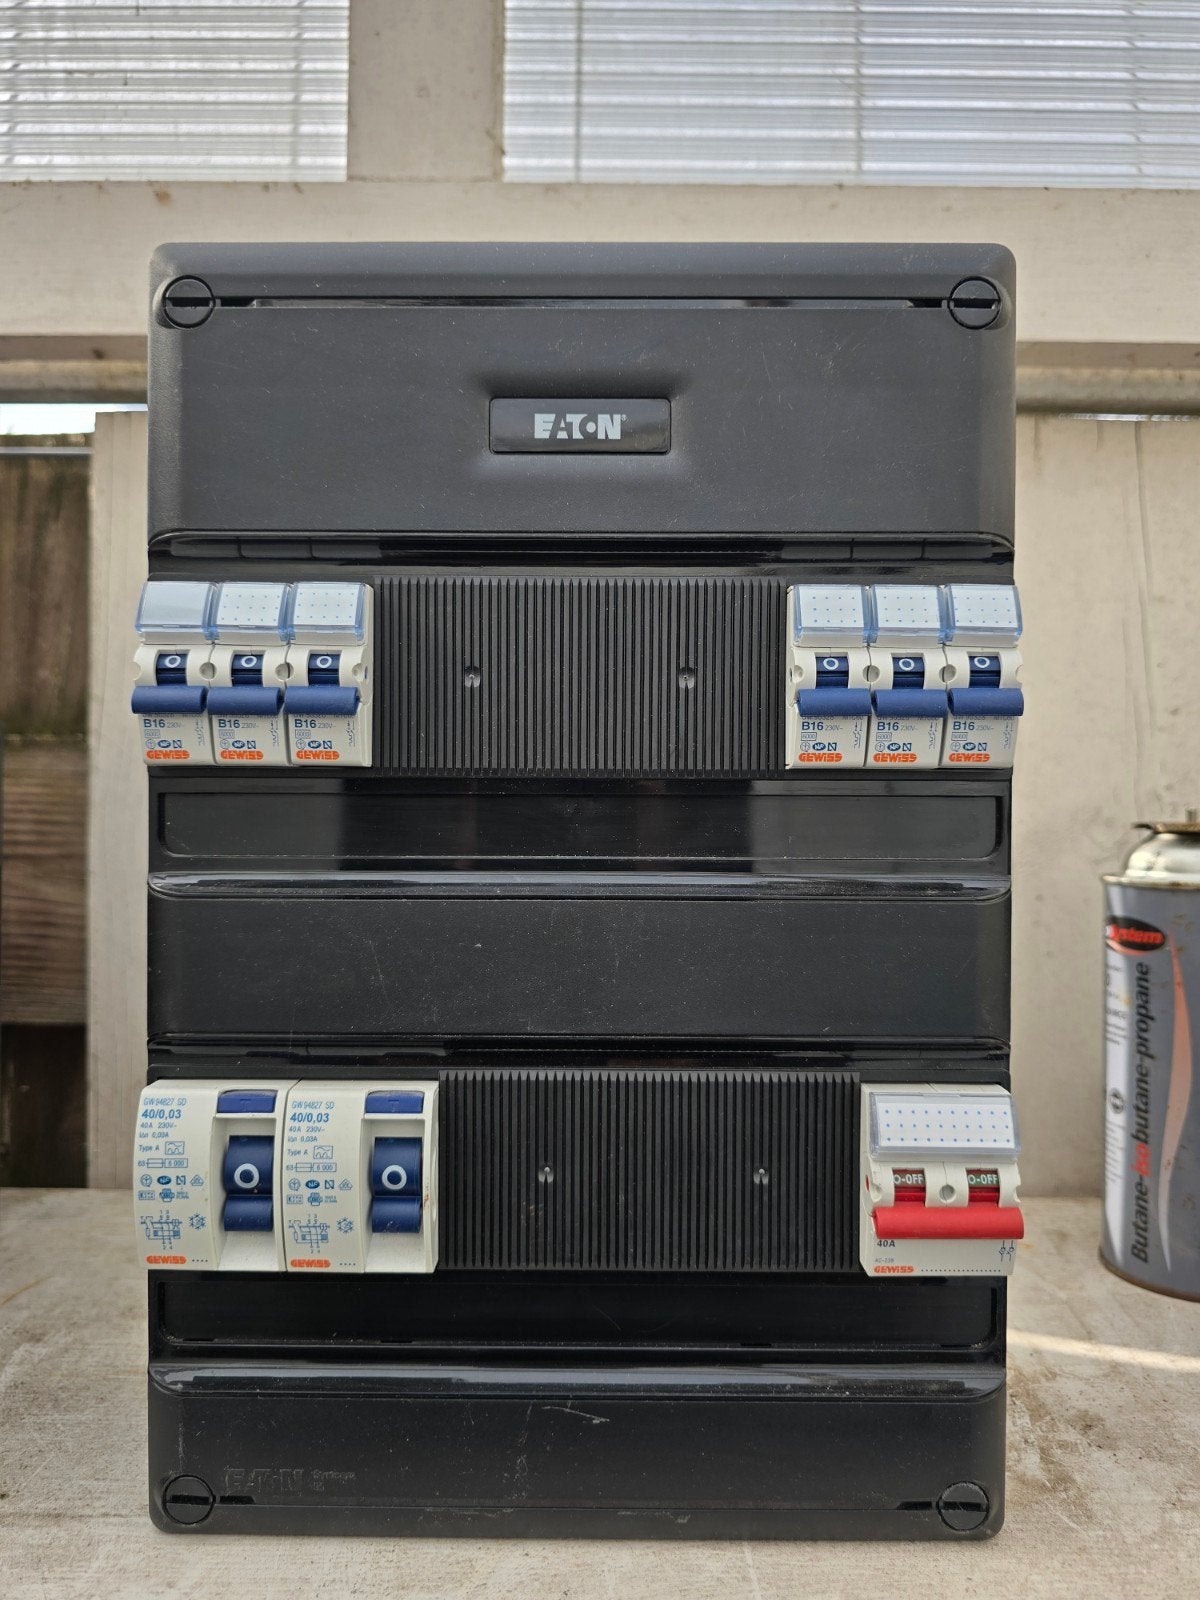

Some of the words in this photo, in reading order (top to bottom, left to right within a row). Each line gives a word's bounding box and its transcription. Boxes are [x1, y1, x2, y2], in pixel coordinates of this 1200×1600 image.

[534, 413, 622, 440] EATON
[144, 719, 165, 728] B16
[218, 719, 240, 728] B16
[294, 719, 316, 728] B16
[802, 722, 824, 731] B16
[877, 722, 899, 731] B16
[953, 721, 975, 731] B16
[142, 1109, 182, 1120] 40/0,03
[290, 1113, 330, 1124] 40/0,03
[139, 1145, 153, 1153] Type
[877, 1240, 896, 1248] 40A
